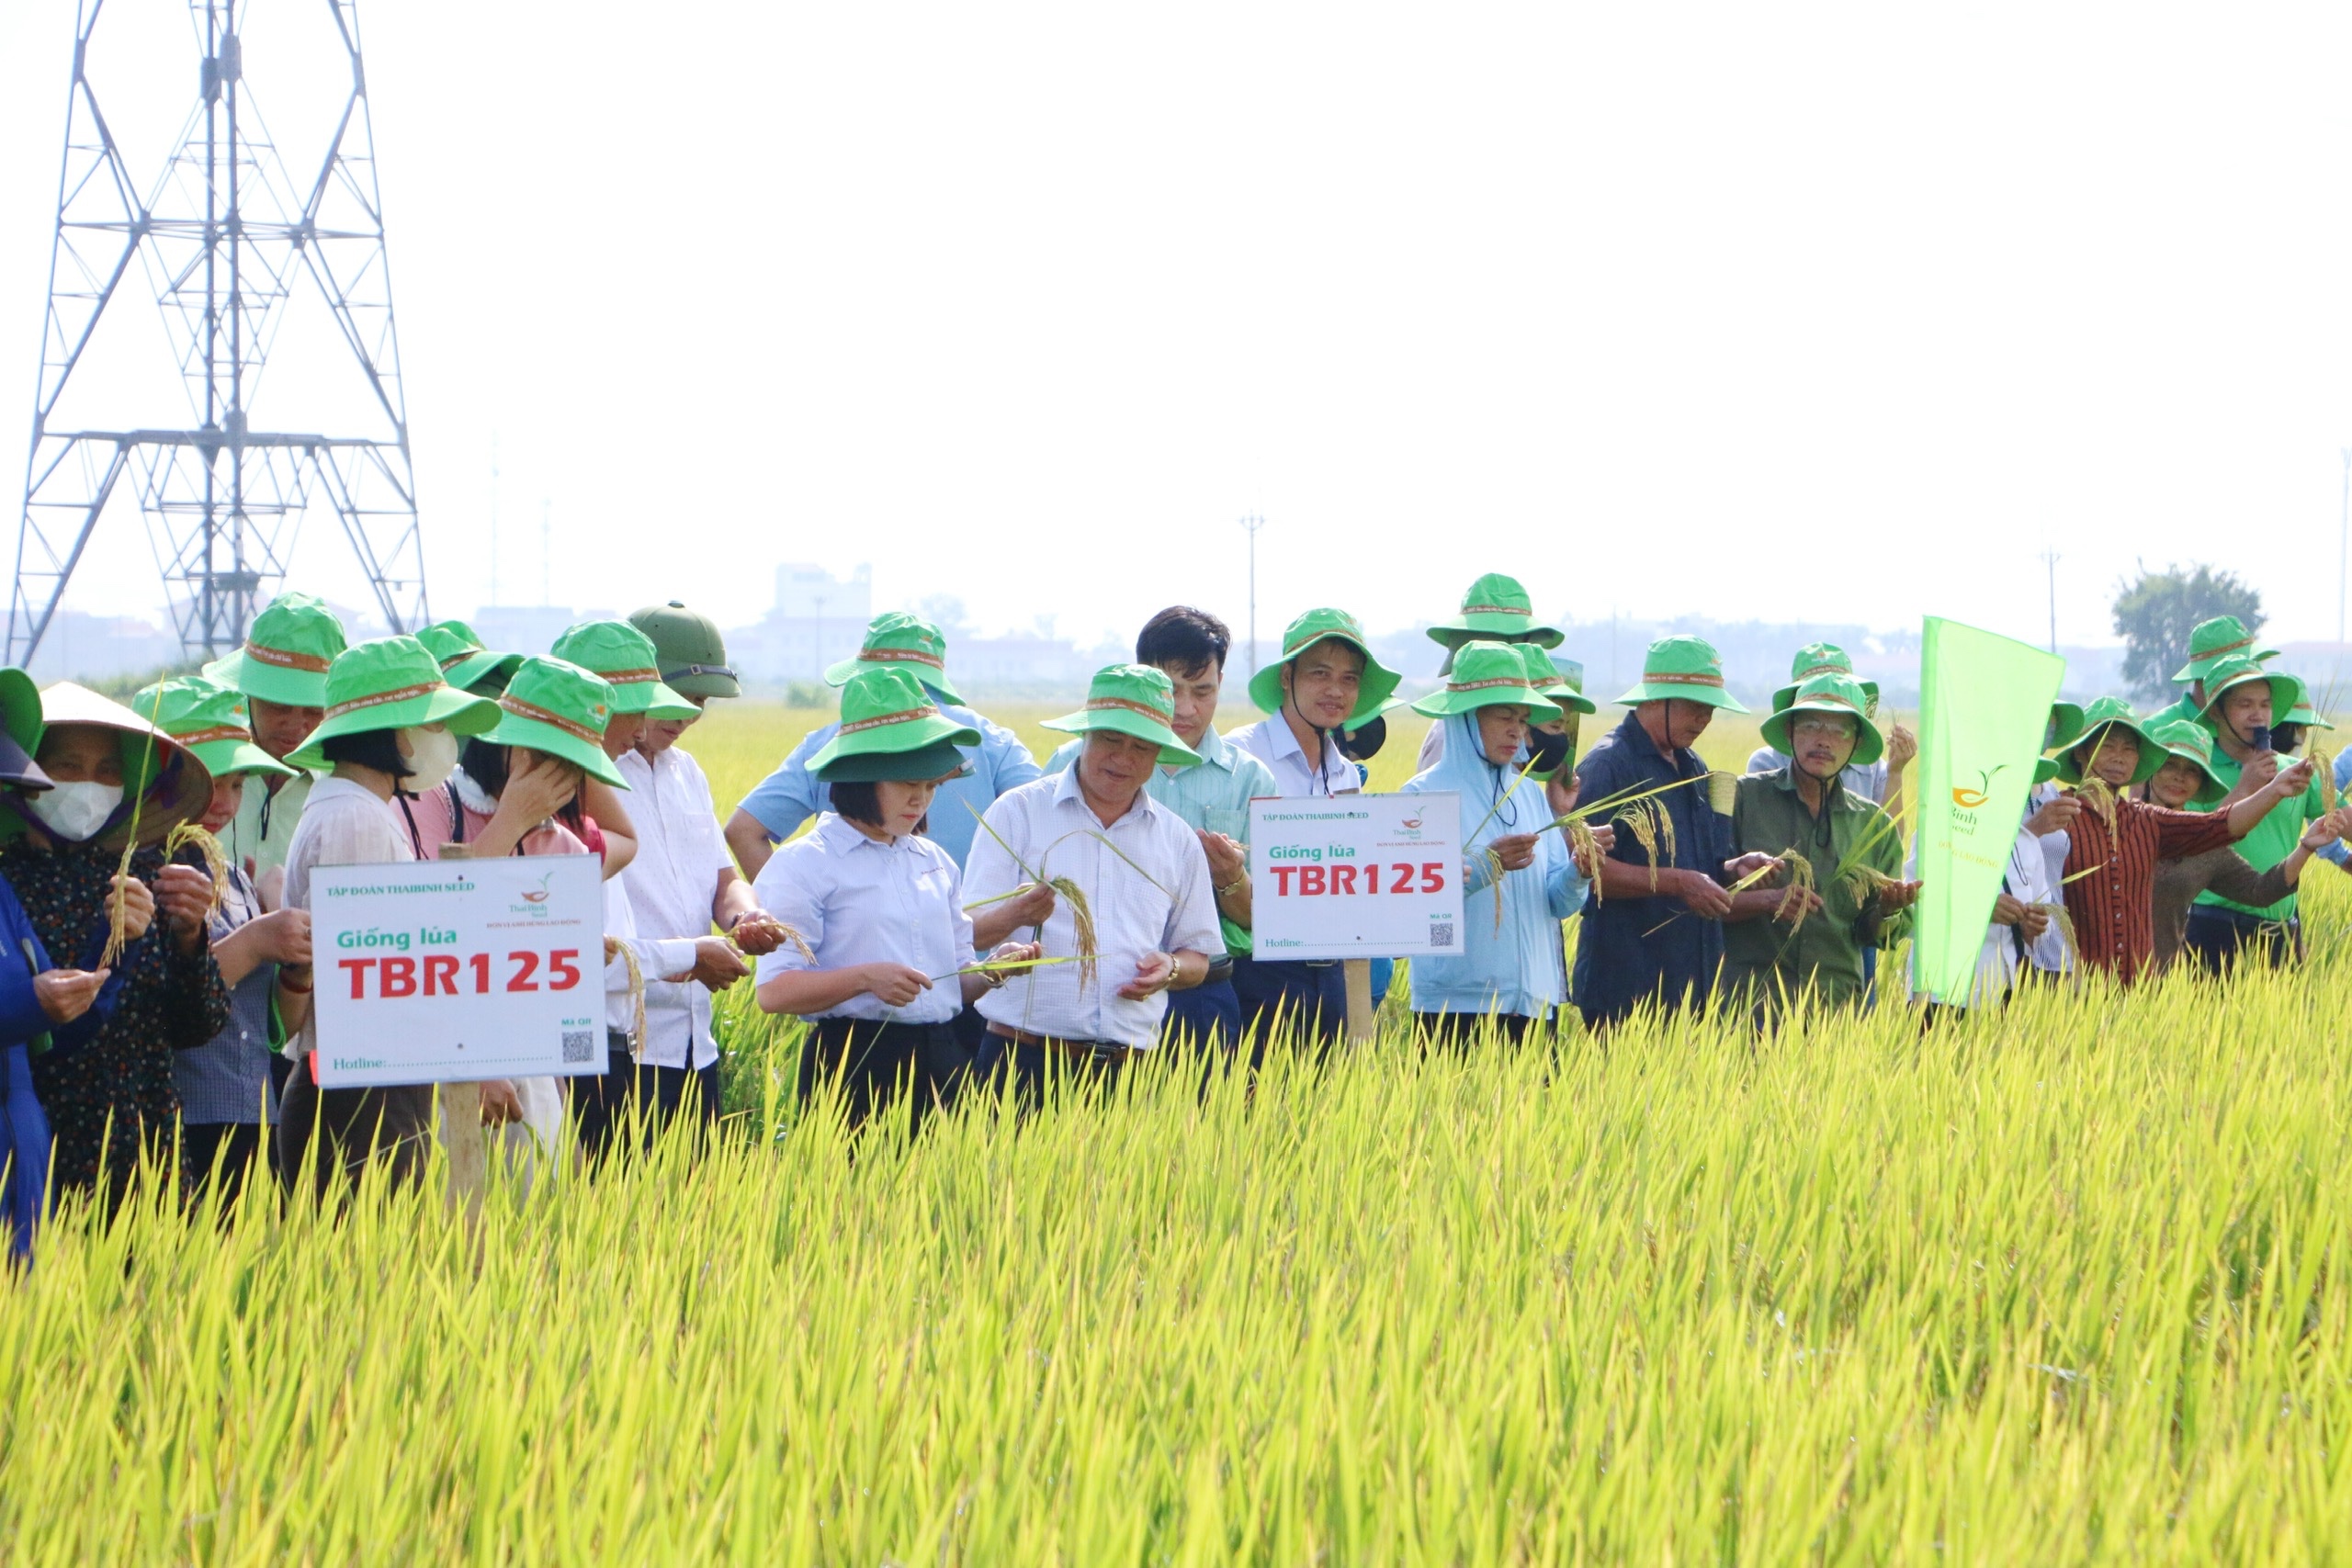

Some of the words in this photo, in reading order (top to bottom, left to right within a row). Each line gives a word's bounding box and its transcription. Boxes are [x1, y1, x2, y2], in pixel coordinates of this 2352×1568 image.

[1305, 812, 1345, 820] THAIBINH
[1346, 811, 1369, 819] SEED
[1269, 844, 1321, 862] Giống
[1329, 844, 1355, 858] lúa
[386, 883, 442, 895] THAIBINH
[445, 882, 475, 892] SEED
[1270, 863, 1444, 897] TBR125
[337, 927, 411, 951] Giống
[420, 927, 458, 945] lúa
[338, 949, 581, 1000] TBR125
